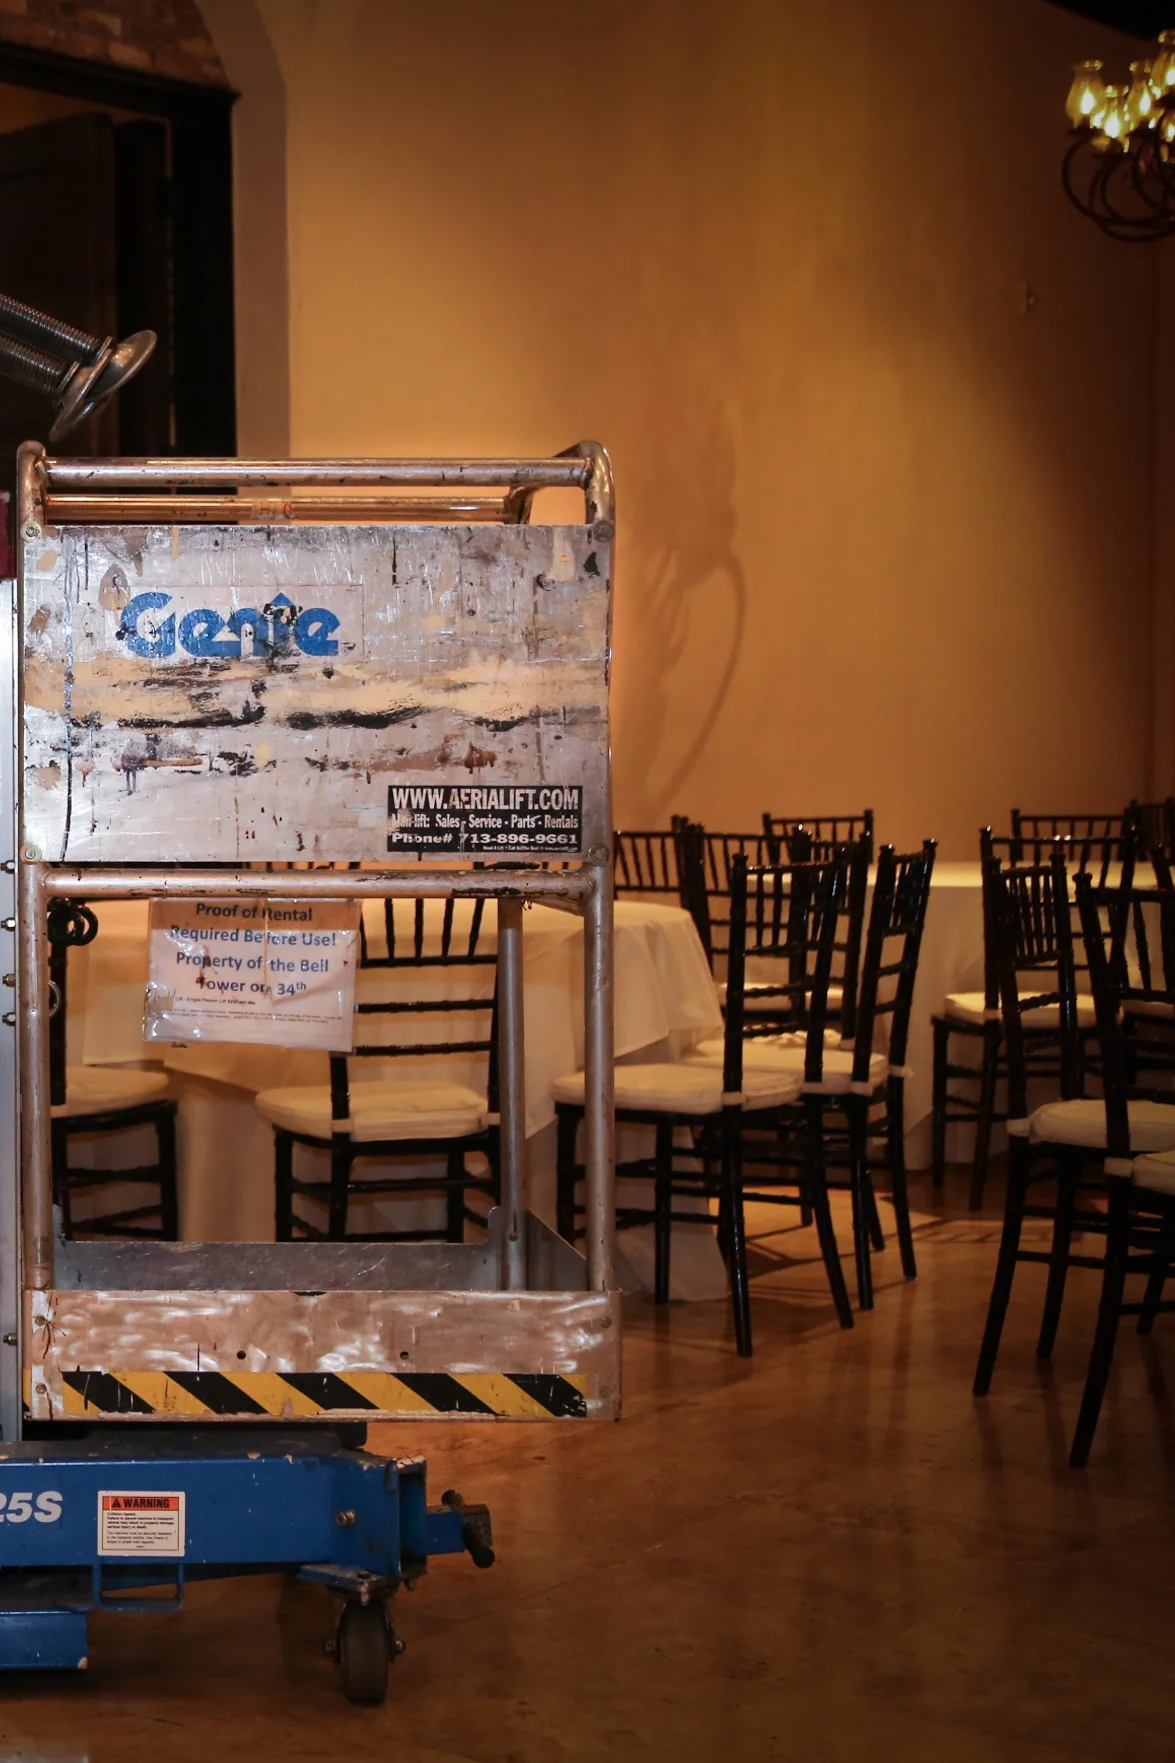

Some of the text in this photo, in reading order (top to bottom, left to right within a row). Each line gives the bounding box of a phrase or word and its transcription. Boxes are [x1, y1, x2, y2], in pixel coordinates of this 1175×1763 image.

[121, 592, 340, 658] Genie
[392, 788, 579, 811] WWW.AERIALIFT.COM
[435, 813, 460, 828] Sales
[469, 814, 502, 829] Service
[511, 814, 537, 829] Parts
[544, 814, 579, 829] Rentals
[391, 832, 578, 844] Phone# 713-896-9661
[196, 902, 313, 921] Proof of Rental
[170, 925, 336, 946] Required Before Use!
[176, 951, 329, 972] Property of the Bell
[277, 981, 307, 996] 34th
[123, 1498, 170, 1509] WARNING
